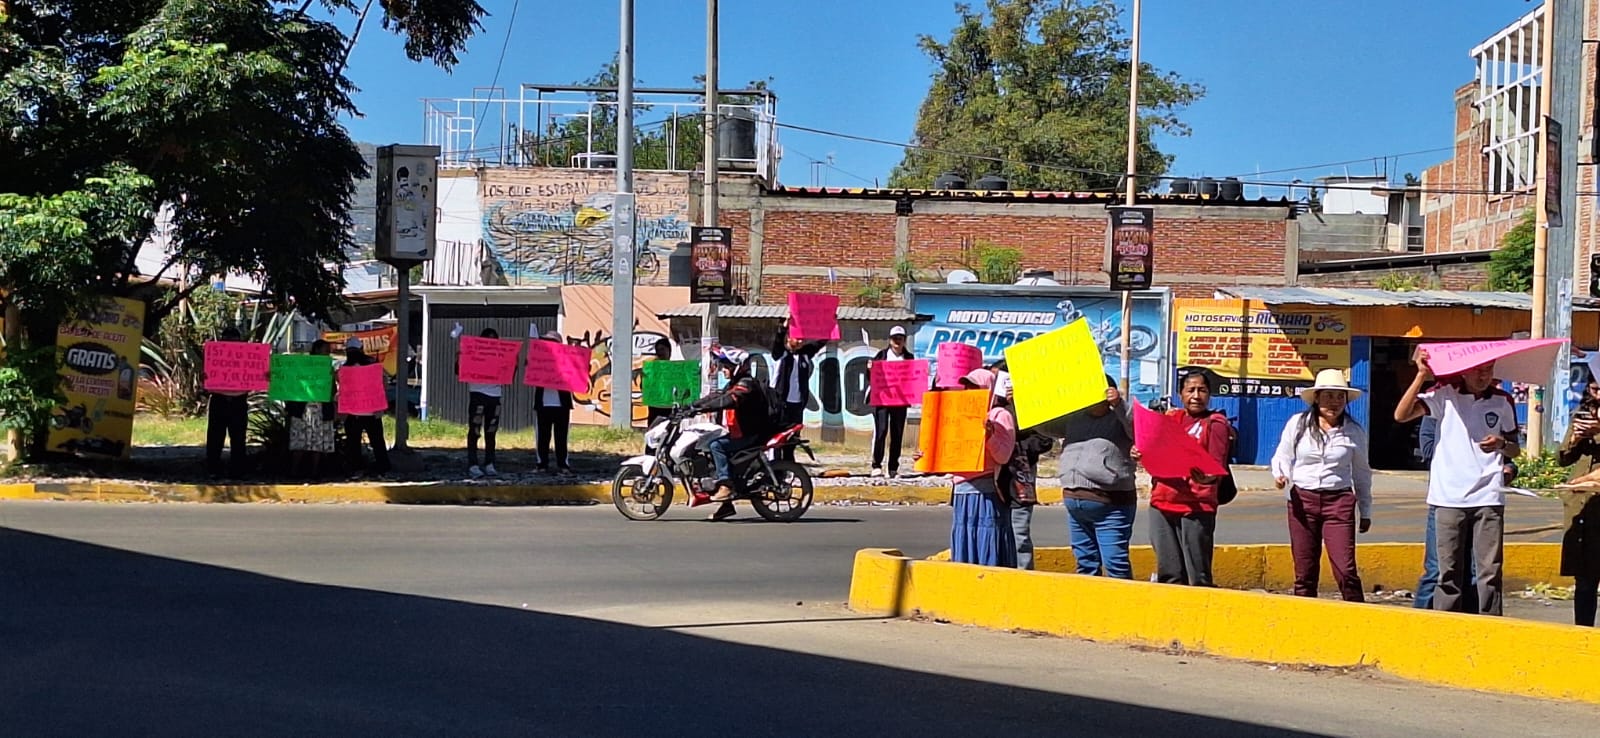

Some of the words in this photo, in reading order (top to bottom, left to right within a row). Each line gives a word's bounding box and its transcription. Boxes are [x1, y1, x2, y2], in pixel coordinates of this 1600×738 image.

[483, 184, 503, 198] LOS
[509, 184, 530, 197] QUE
[539, 180, 590, 197] ESPERAN
[948, 311, 988, 323] MOTO
[990, 312, 1055, 324] SERVICIO
[1184, 314, 1255, 323] MOTOSERVICIO
[1255, 312, 1313, 326] RICHARD
[67, 348, 117, 371] GRATIS
[1260, 385, 1270, 394] 20
[1271, 385, 1282, 394] 23
